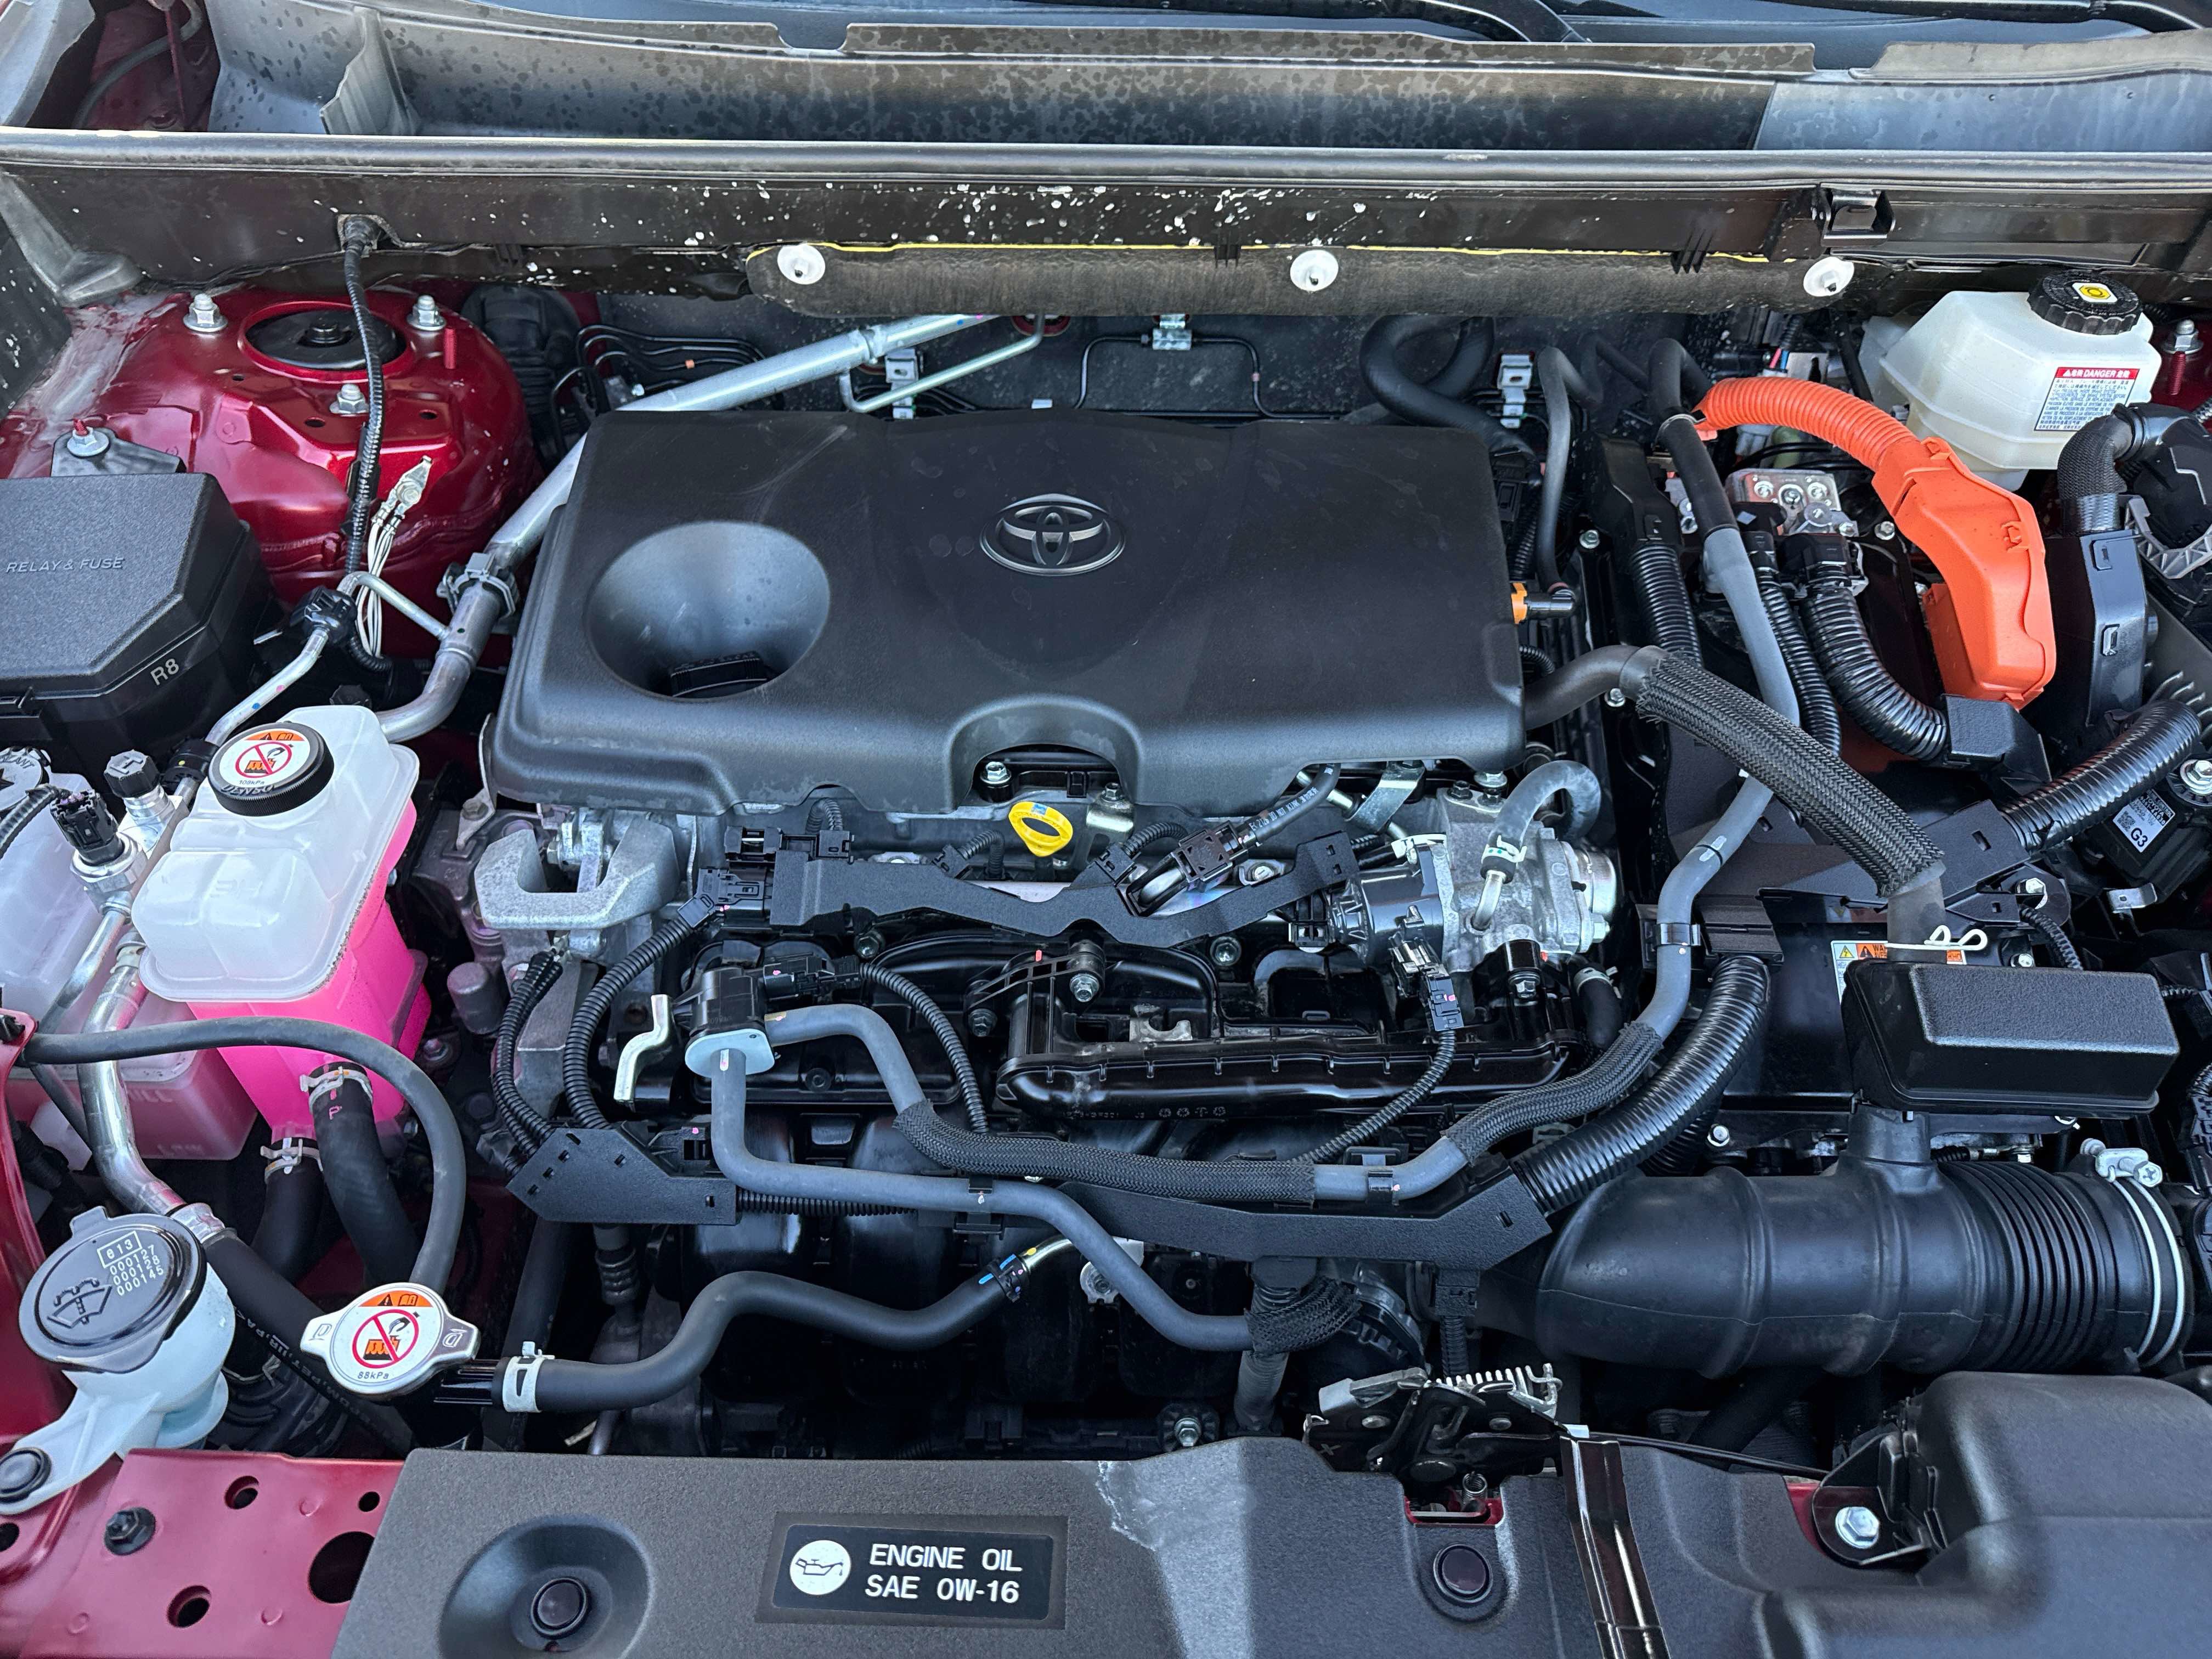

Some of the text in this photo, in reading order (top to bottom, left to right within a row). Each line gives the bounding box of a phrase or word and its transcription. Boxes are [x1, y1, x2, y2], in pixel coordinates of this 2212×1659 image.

[5, 556, 125, 574] RELAY & FUSE
[150, 658, 179, 686] R8
[221, 785, 274, 796] DENSO
[2146, 795, 2164, 817] TOYOTA
[2131, 828, 2148, 847] G3
[110, 1244, 155, 1275] 000127
[113, 1255, 160, 1285] 000128
[117, 1266, 163, 1296] 000145
[357, 1371, 390, 1379] 88kPa
[870, 1543, 1023, 1572] ENGINE OIL
[865, 1574, 1020, 1604] SAE 0W-16
